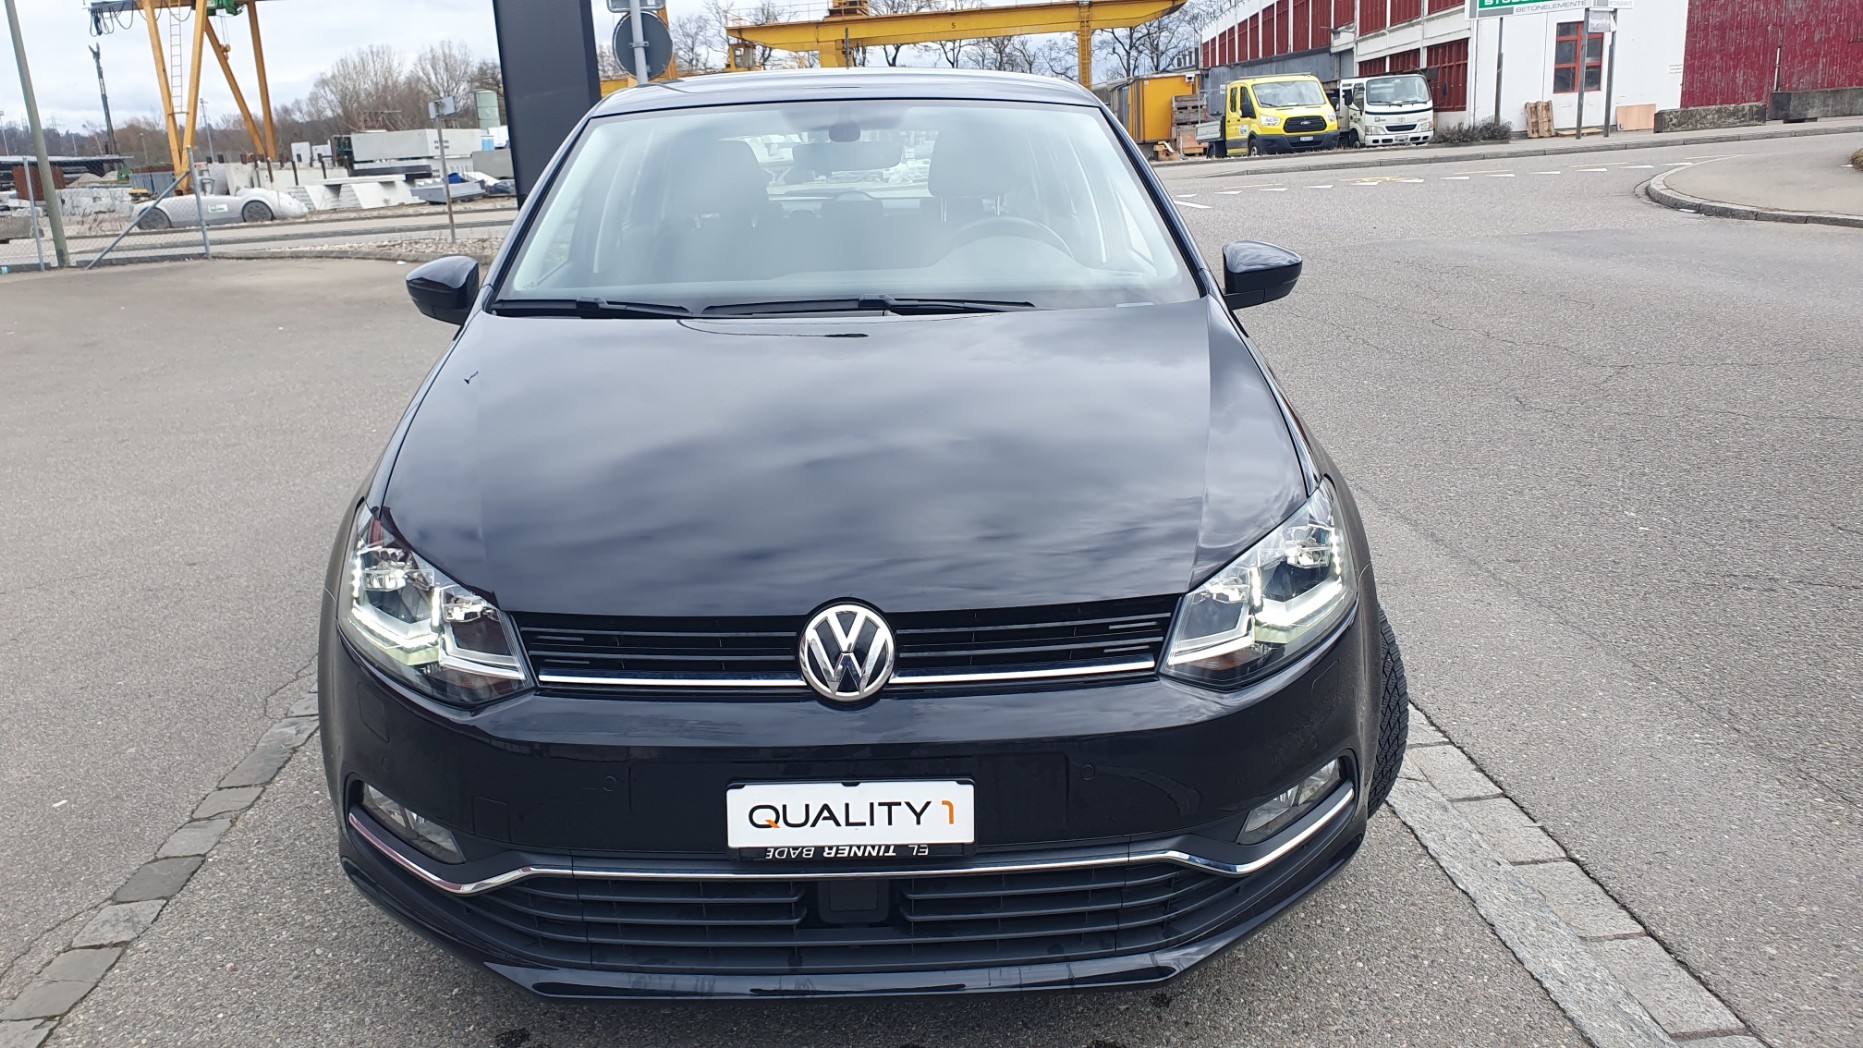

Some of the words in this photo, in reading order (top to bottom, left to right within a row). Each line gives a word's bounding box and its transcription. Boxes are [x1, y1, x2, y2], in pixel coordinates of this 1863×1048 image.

[1515, 0, 1587, 13] BETONELEMENTE
[748, 800, 932, 829] QUALITY
[941, 800, 955, 825] 1
[823, 845, 897, 858] TINNER
